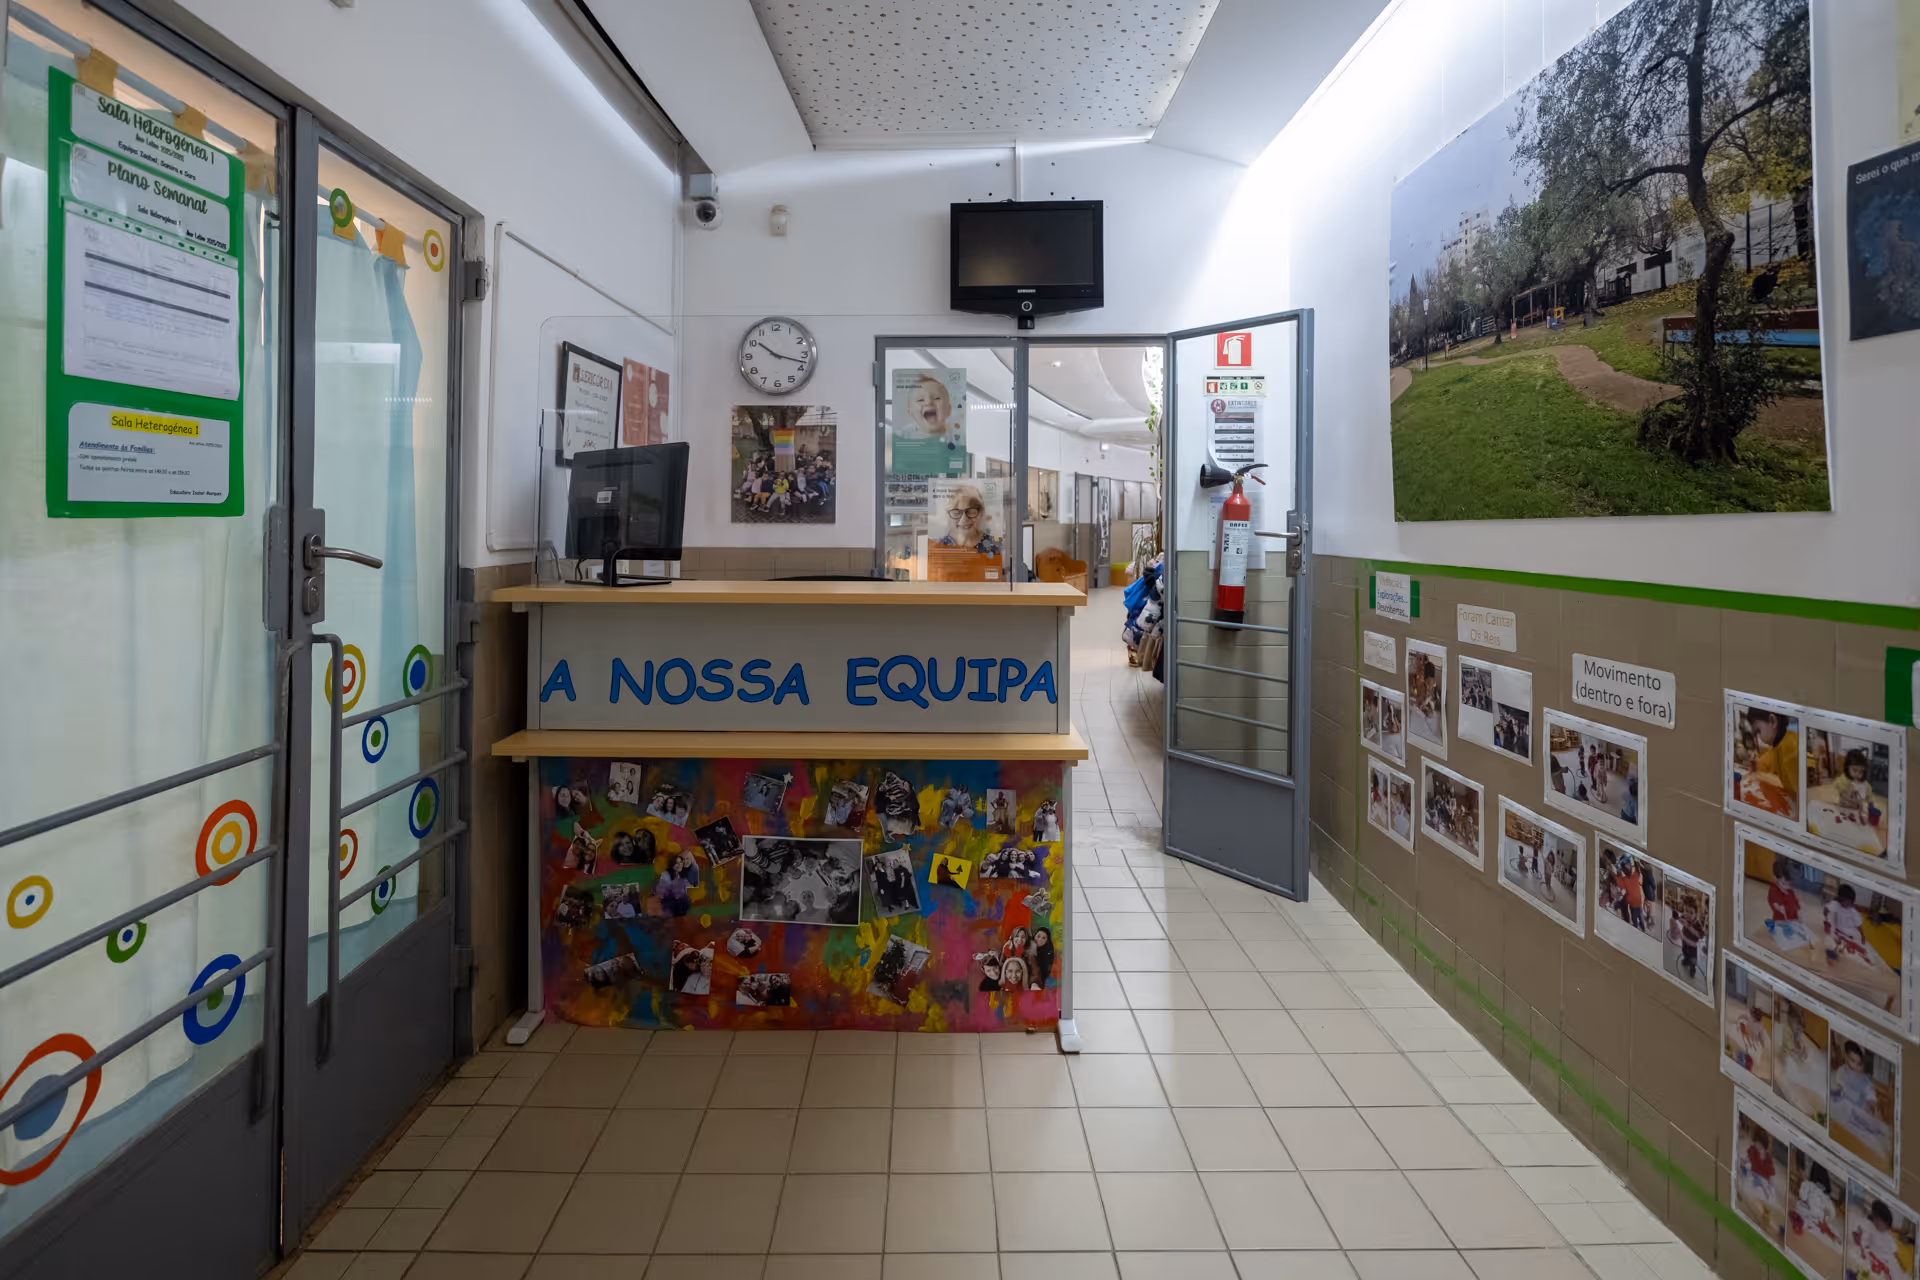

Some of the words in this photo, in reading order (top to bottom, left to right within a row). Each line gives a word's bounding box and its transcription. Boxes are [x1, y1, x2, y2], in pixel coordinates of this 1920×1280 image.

[97, 97, 131, 125] Sala
[134, 113, 208, 162] Heterogénea
[1856, 166, 1880, 184] Serei
[1881, 164, 1889, 174] o
[1890, 156, 1910, 172] que
[107, 160, 150, 190] Plano
[153, 180, 208, 214] Semanal
[758, 328, 765, 337] 11
[771, 324, 781, 332] 12
[749, 339, 757, 347] 10
[796, 337, 804, 345] 2
[745, 353, 753, 361] 9
[801, 350, 809, 359] 3
[750, 366, 759, 375] 8
[797, 364, 805, 372] 4
[760, 376, 768, 385] 7
[773, 379, 782, 388] 6
[787, 375, 796, 384] 5
[111, 416, 133, 428] Sala
[135, 418, 193, 435] Heterogénea
[195, 425, 199, 435] 1
[79, 441, 119, 451] Atendimento
[1458, 608, 1484, 624] Foram
[1485, 612, 1514, 628] Cantar
[1470, 628, 1482, 642] Os
[1483, 630, 1501, 646] Reis
[1584, 659, 1662, 691] Movimento
[540, 659, 576, 703] A
[608, 657, 810, 705] NOSSA
[846, 654, 1058, 709] EQUIPA
[1575, 680, 1622, 707] (dentro
[1626, 697, 1635, 710] e
[1637, 695, 1672, 724] fora)
